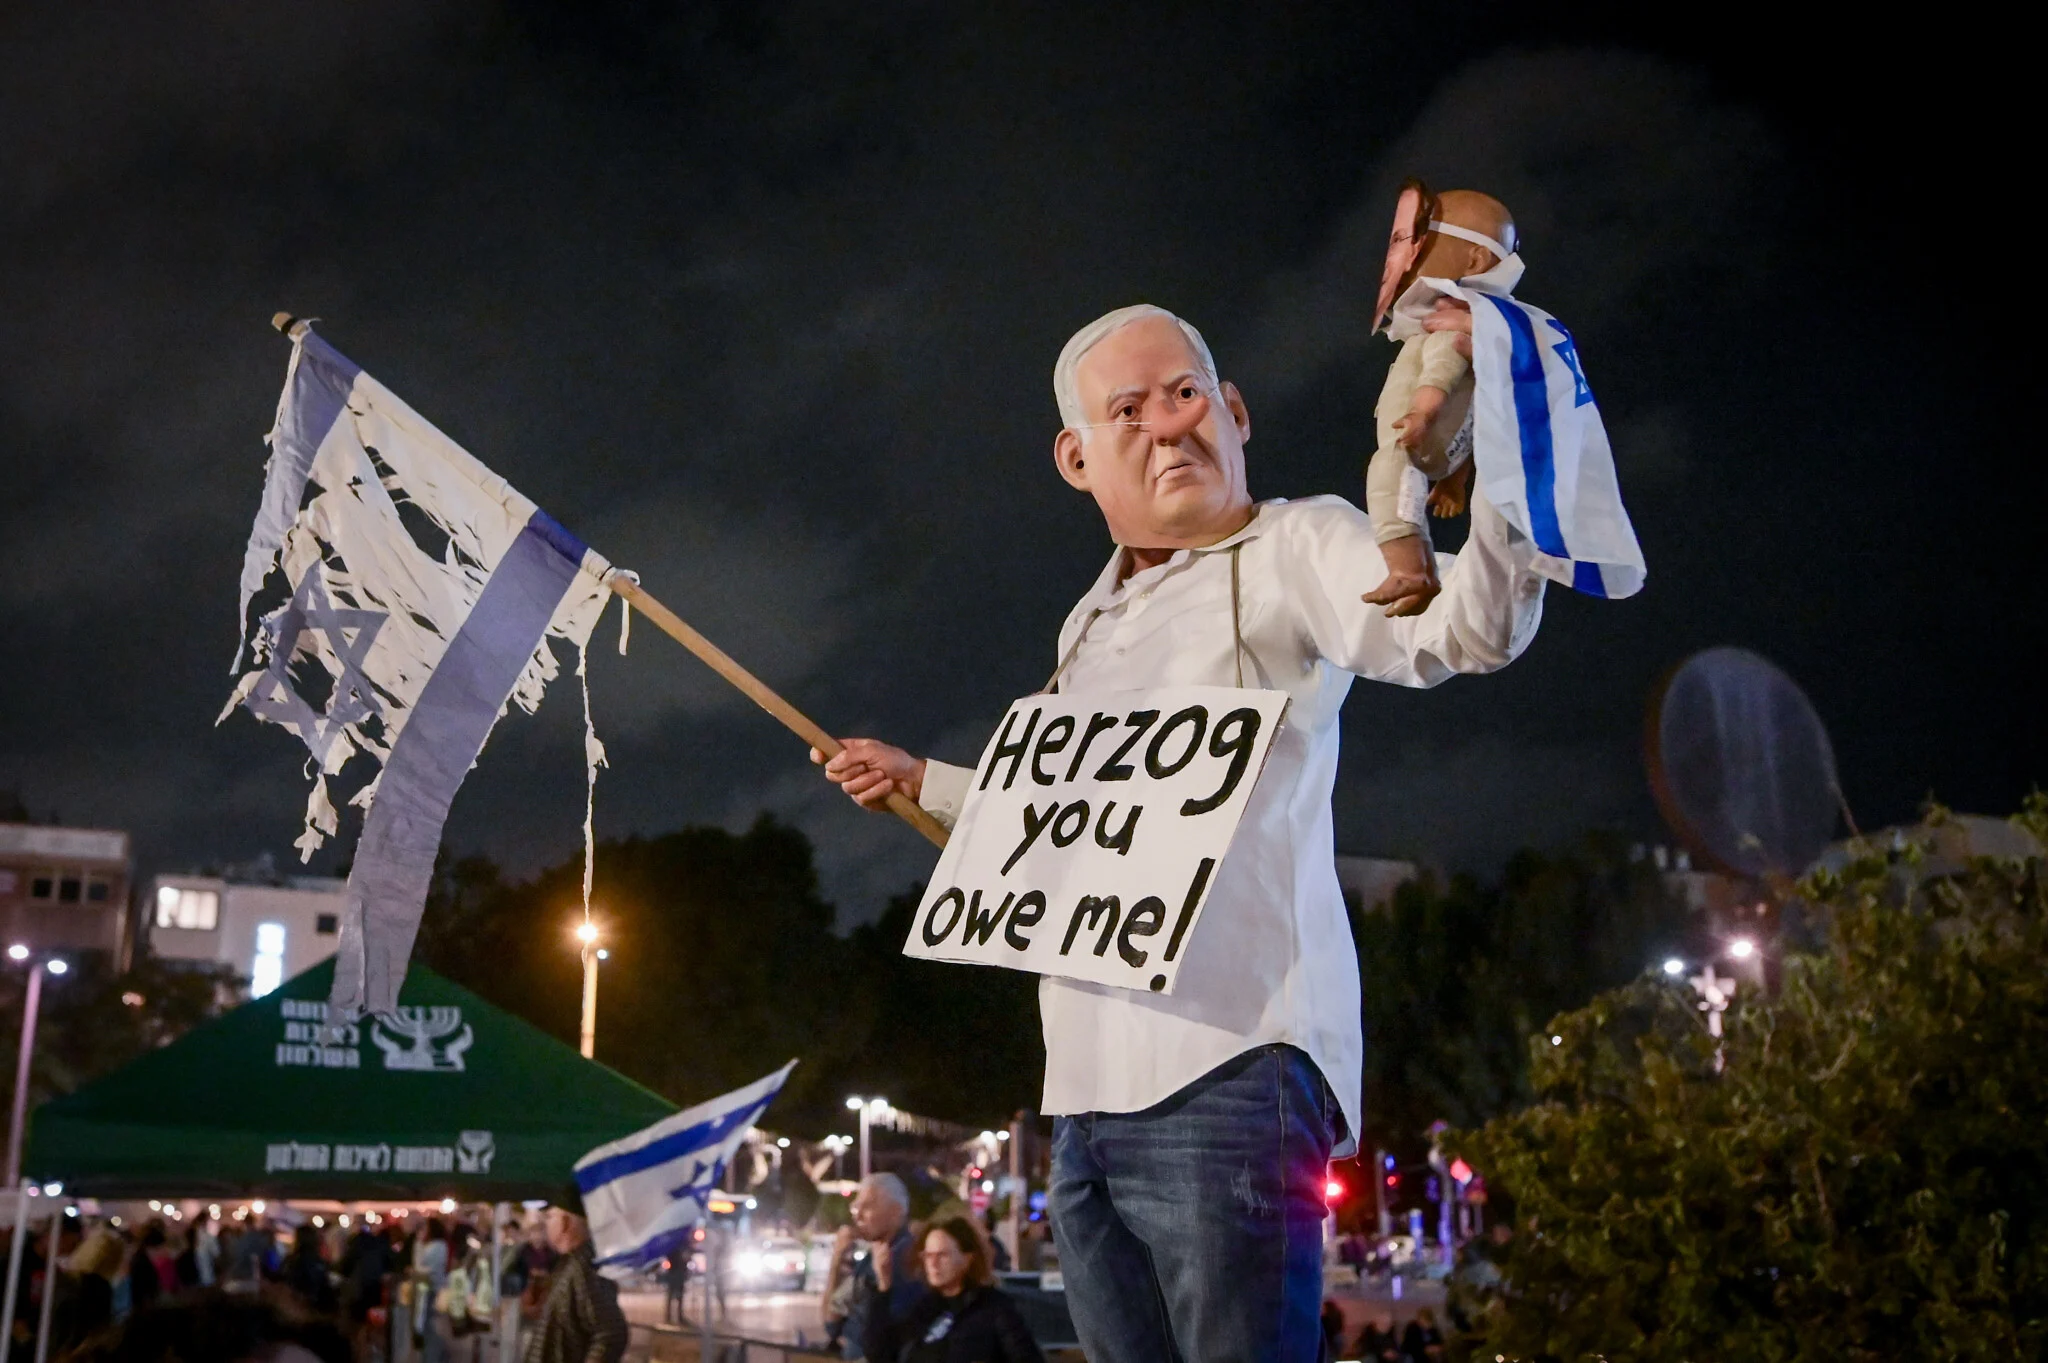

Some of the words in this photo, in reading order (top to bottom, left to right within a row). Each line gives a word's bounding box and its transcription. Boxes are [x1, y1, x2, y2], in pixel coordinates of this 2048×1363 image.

[978, 704, 1262, 816] Herzog
[1000, 799, 1144, 876] you
[922, 886, 1047, 951] owe
[1059, 857, 1216, 991] me!
